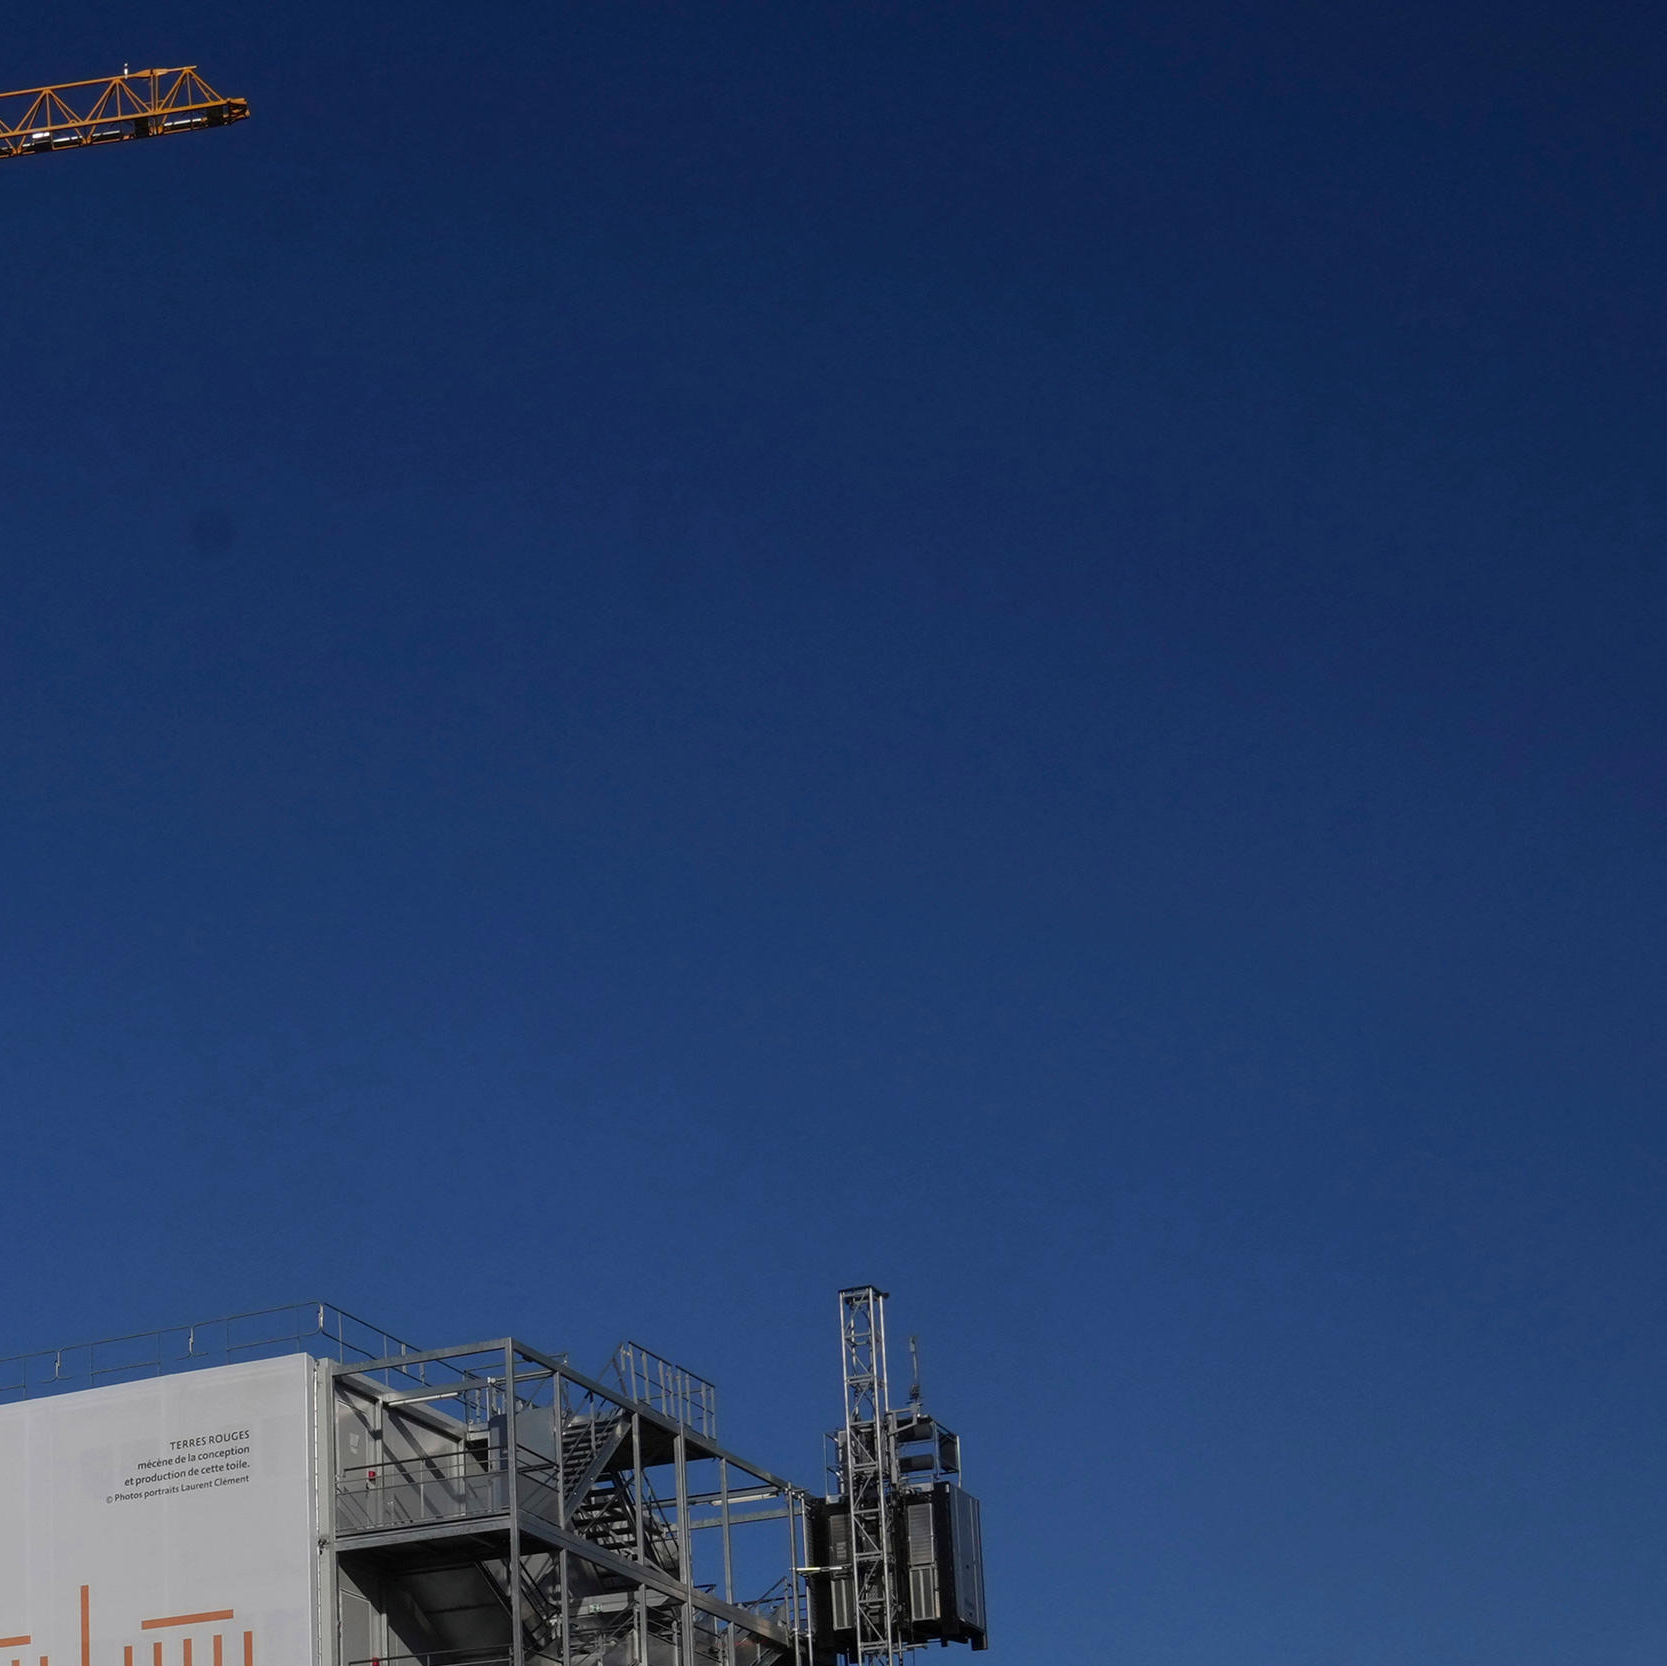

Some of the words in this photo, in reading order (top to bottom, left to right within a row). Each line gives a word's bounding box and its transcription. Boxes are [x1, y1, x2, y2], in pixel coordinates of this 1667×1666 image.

[169, 1437, 207, 1450] TERRES
[208, 1429, 250, 1445] ROUGES
[137, 1457, 174, 1470] mécène
[174, 1454, 187, 1464] de
[187, 1452, 197, 1462] la
[197, 1446, 250, 1462] conception
[124, 1476, 135, 1487] et
[135, 1469, 187, 1487] production
[187, 1467, 200, 1477] de
[200, 1464, 225, 1475] cette
[225, 1460, 251, 1471] toile.
[114, 1490, 143, 1502] Photos
[144, 1485, 180, 1500] portraits
[181, 1481, 213, 1492] Laurent
[213, 1475, 250, 1488] Clément
